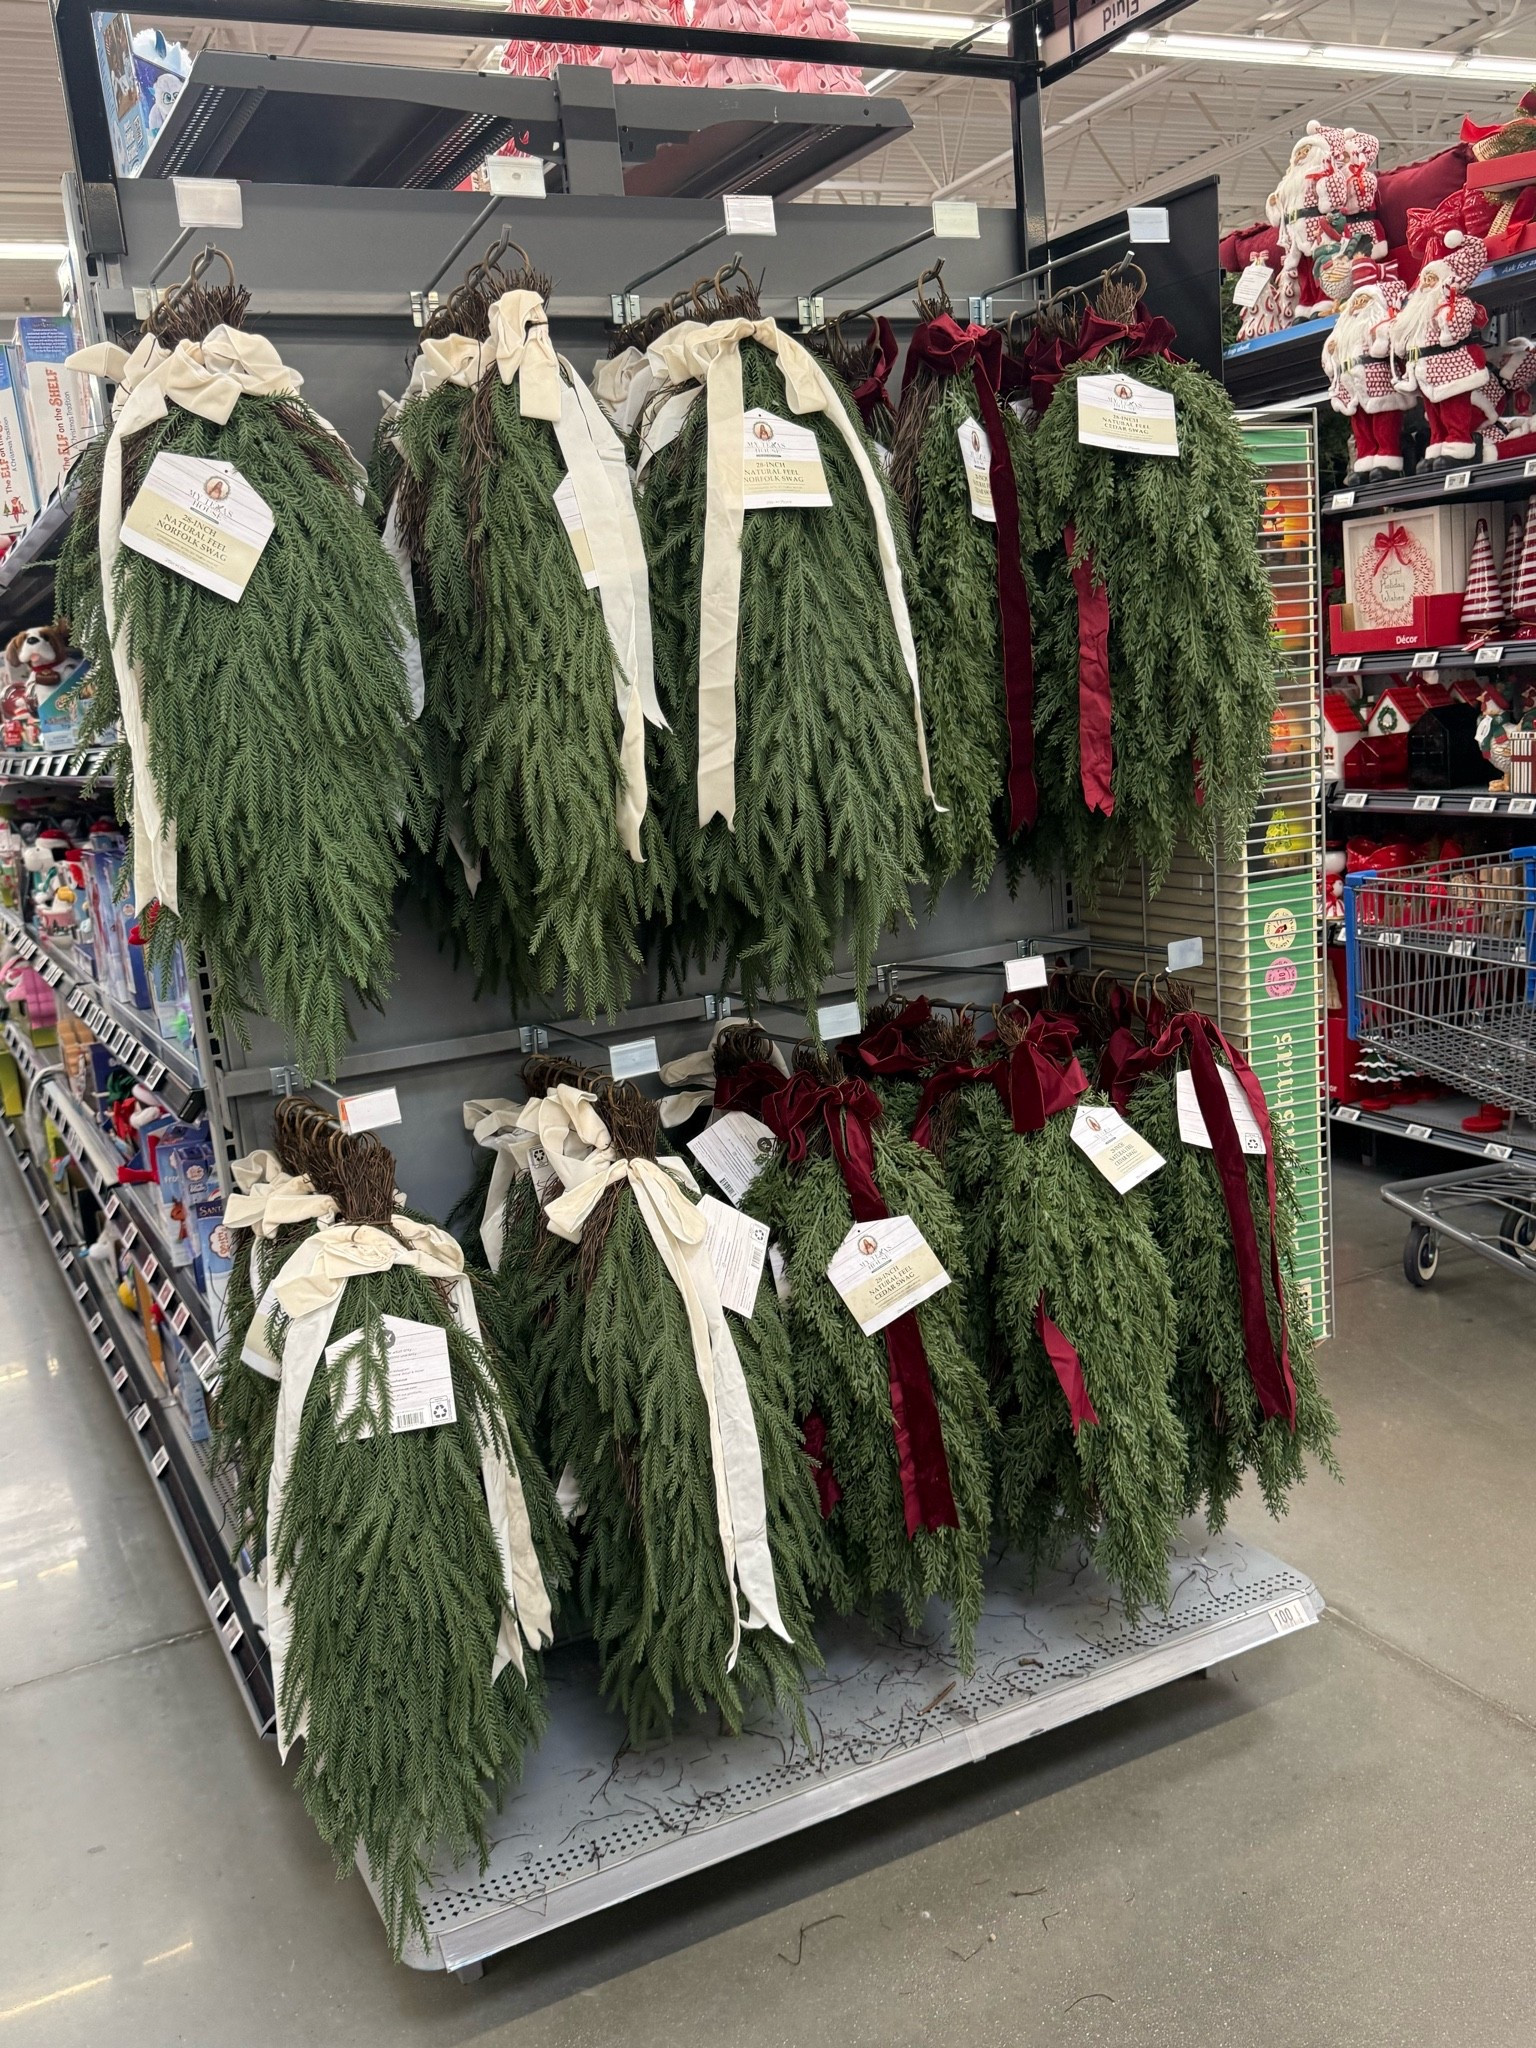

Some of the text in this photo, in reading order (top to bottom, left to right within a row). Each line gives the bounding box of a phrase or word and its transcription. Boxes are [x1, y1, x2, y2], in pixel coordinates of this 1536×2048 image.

[1102, 0, 1139, 31] Fluid
[65, 391, 74, 416] Tradition
[3, 416, 13, 440] Tradition
[46, 368, 71, 473] The ELF on the SHELF
[67, 415, 78, 443] Christmas
[1102, 417, 1134, 428] NATURAL
[1104, 423, 1127, 431] CEDAR
[7, 438, 17, 466] Christmas
[0, 459, 12, 481] ELF
[744, 468, 781, 476] NATURAL
[5, 478, 13, 494] The
[188, 489, 233, 518] MY TEXAS
[192, 500, 223, 520] HOUSE
[163, 513, 206, 543] NATURAL
[206, 538, 228, 553] FEEL
[182, 514, 217, 537] 28-INCH
[156, 519, 200, 548] NORFOLK
[199, 543, 228, 562] SWAG
[1379, 578, 1406, 593] Holiday
[1395, 635, 1418, 645] Décor
[199, 1206, 222, 1216] SANT
[869, 1274, 898, 1295] NATURAL
[874, 1284, 896, 1301] CEDAR
[895, 1271, 915, 1286] SWAG
